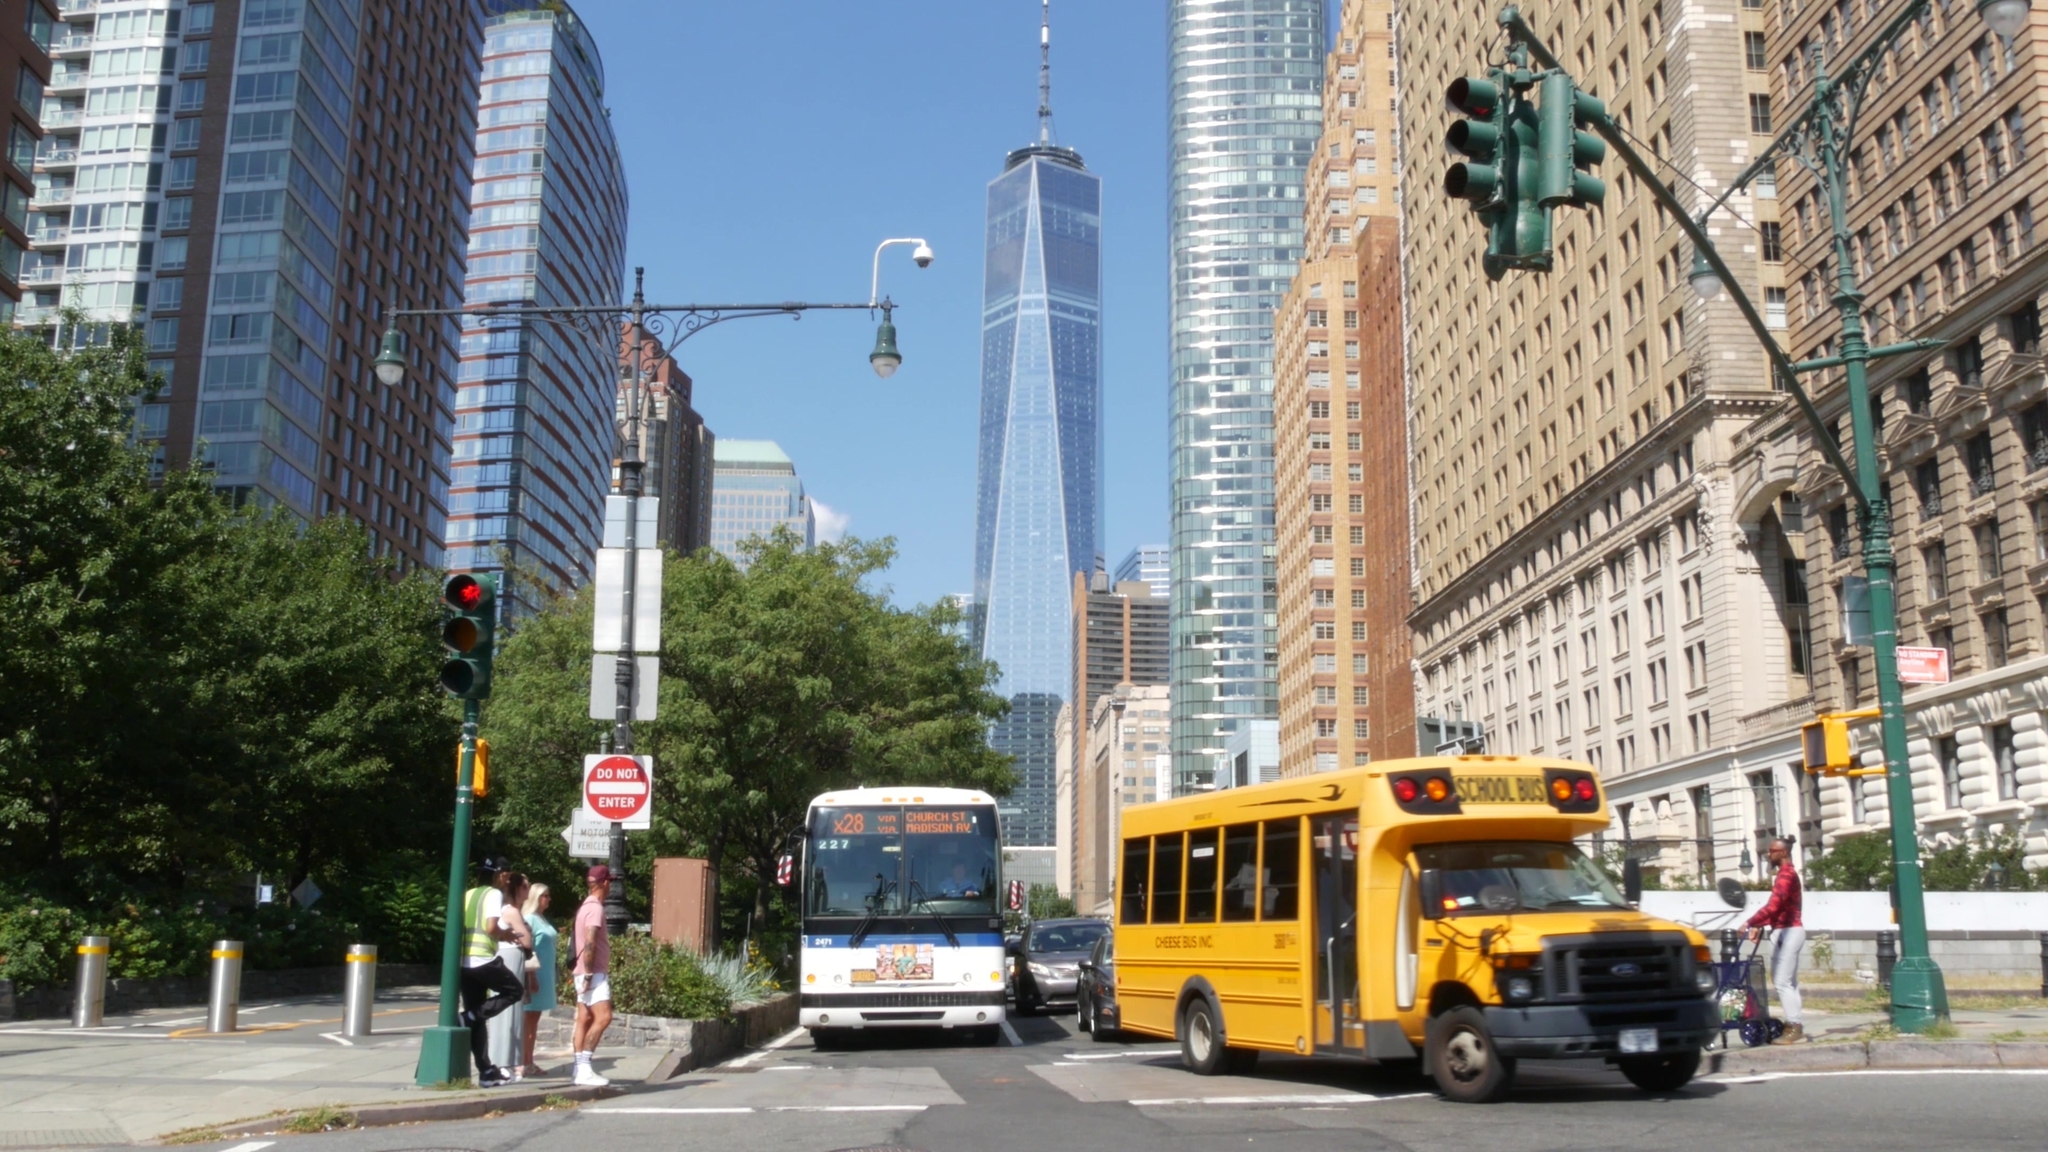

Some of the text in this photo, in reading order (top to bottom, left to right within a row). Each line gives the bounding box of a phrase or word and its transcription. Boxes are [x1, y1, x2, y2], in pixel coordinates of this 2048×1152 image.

[1908, 651, 1939, 659] STANDING
[597, 768, 639, 779] DO NOT
[1457, 777, 1545, 802] SCHOOL BUS
[598, 797, 635, 808] ENTER
[906, 812, 949, 822] CHURCH
[952, 812, 966, 822] ST
[580, 828, 610, 837] MOTOR
[877, 823, 971, 833] VIA MADISON AV
[815, 937, 832, 946] 2471
[1155, 936, 1181, 949] CHEESE
[1182, 936, 1197, 948] BUS
